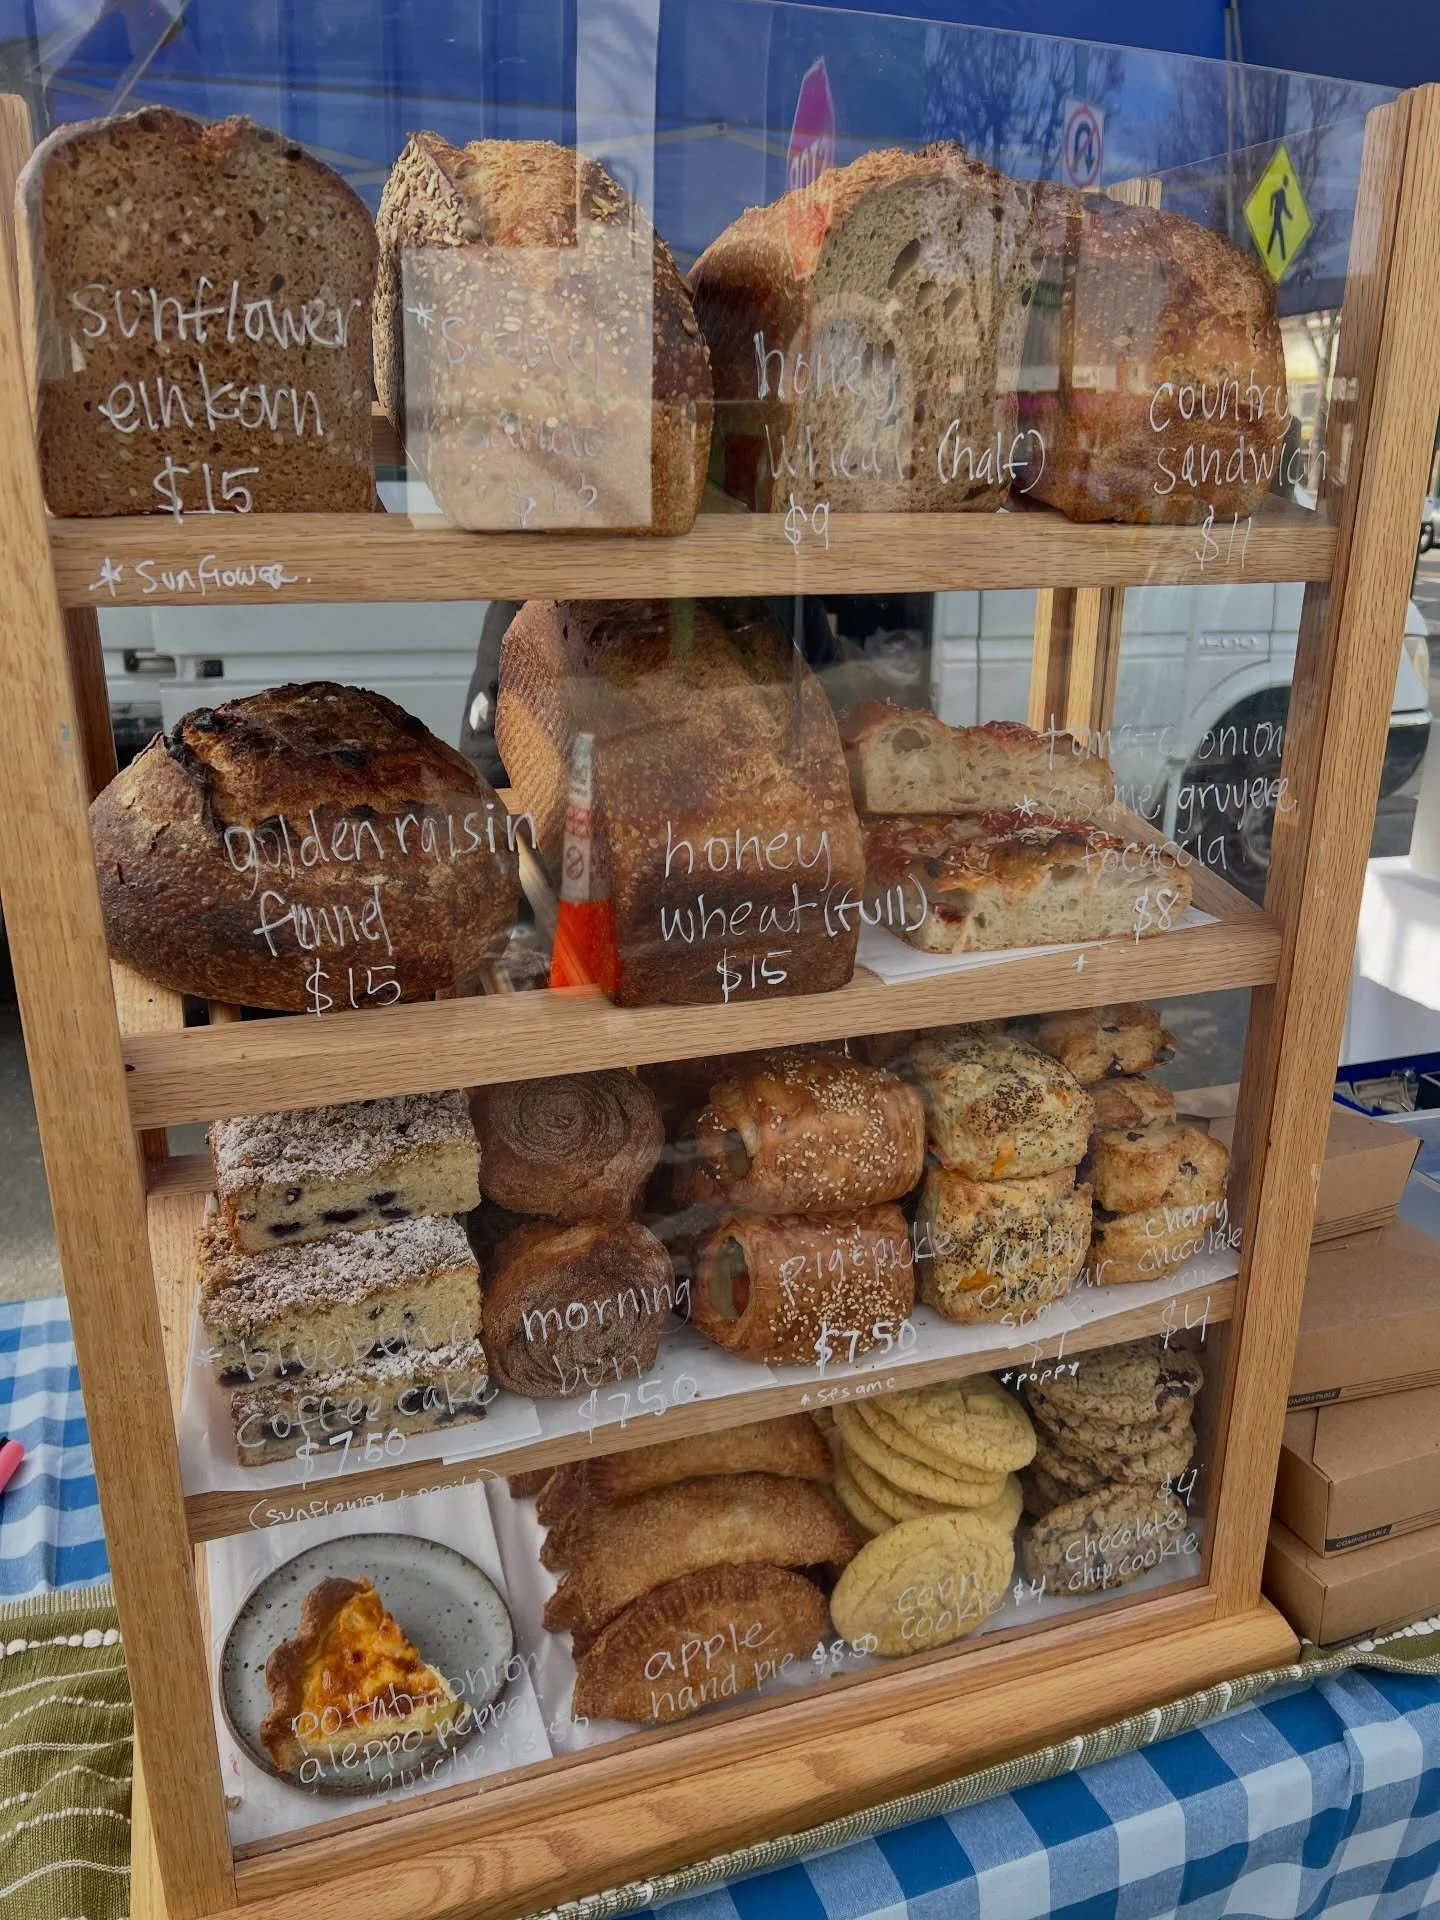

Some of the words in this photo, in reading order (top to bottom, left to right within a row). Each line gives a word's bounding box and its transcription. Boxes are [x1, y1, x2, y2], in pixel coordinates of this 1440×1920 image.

[72, 276, 361, 350] sunflower
[98, 361, 324, 437] einkorn
[753, 330, 900, 420] honey
[1150, 368, 1293, 440] country
[765, 423, 905, 482] wheat
[937, 418, 1046, 494] (half)
[1153, 435, 1327, 496] sandwich
[153, 456, 260, 525] $15
[783, 493, 830, 556] $9
[1195, 504, 1252, 571] $11
[1197, 720, 1283, 759] onion
[1176, 776, 1298, 834] gruyere
[223, 808, 385, 900] golden
[394, 802, 538, 864] raisin
[663, 820, 833, 893] honey
[660, 883, 818, 944] wheat
[823, 873, 928, 938] (full)
[1131, 885, 1180, 945] $8
[305, 957, 401, 1017] $15
[715, 947, 793, 1003] $15
[1137, 1223, 1244, 1274] chocolate
[1143, 1198, 1230, 1241] cherry
[779, 1239, 846, 1306] pig
[521, 1278, 692, 1342] morning
[1159, 1295, 1212, 1351] $4
[551, 1354, 643, 1396] bun
[1016, 1361, 1080, 1391] poppy
[1287, 1390, 1338, 1407] OMPOSTABLE
[236, 1394, 383, 1449] coffee
[396, 1373, 501, 1416] cake
[294, 1426, 407, 1491] $7.50
[1156, 1467, 1200, 1508] $4
[1067, 1561, 1114, 1592] chip
[1117, 1532, 1200, 1577] cookie
[1335, 1527, 1389, 1549] COMPOSTABLE
[895, 1570, 981, 1614] corn
[900, 1593, 1006, 1641] cookie
[1012, 1574, 1047, 1608] $4
[447, 1651, 541, 1701] onion
[643, 1621, 776, 1681] apple
[650, 1663, 738, 1719] hand
[753, 1648, 795, 1692] pie
[811, 1632, 879, 1675] $8.50
[299, 1726, 424, 1781] aleppo
